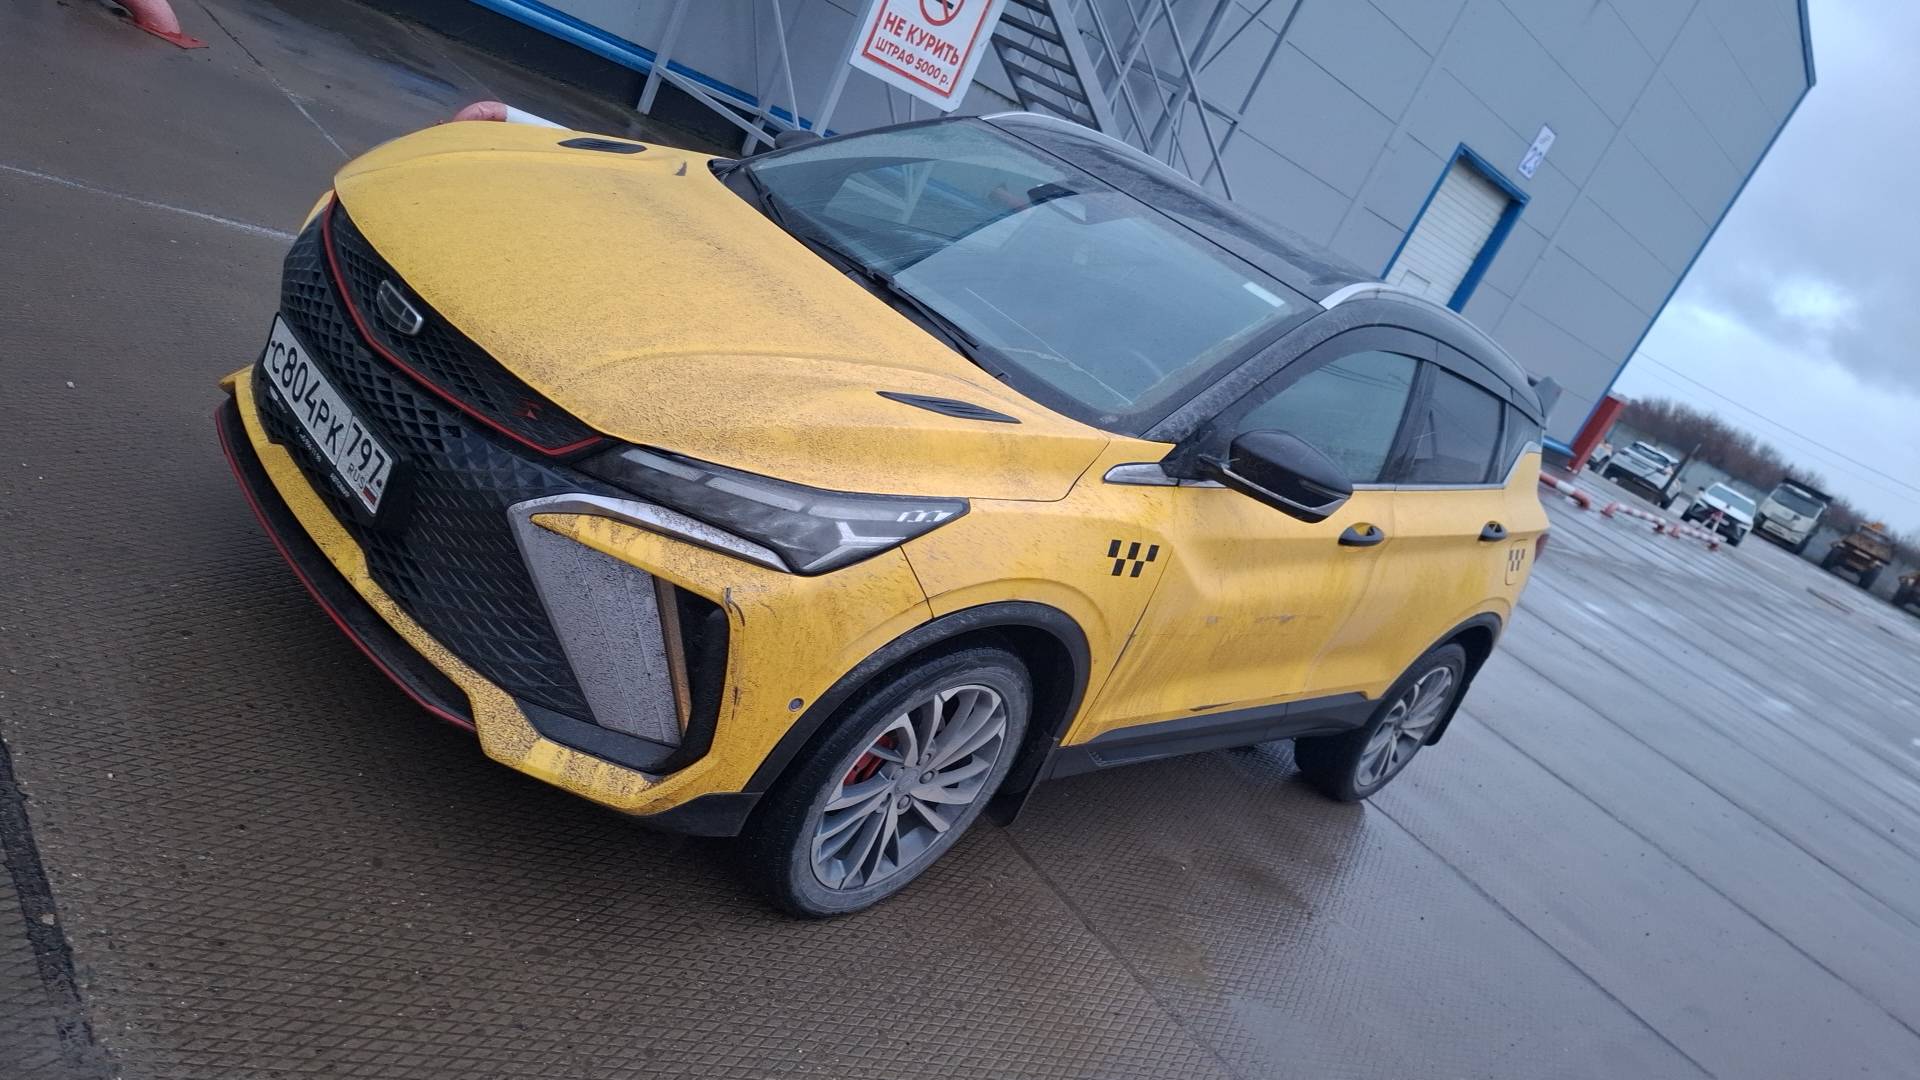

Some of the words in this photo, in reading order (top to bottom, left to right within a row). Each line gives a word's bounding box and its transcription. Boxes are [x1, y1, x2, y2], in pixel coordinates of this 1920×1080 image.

[874, 36, 915, 66] ШТРАФ
[914, 57, 941, 80] 5000
[883, 11, 907, 37] НЕ
[905, 23, 960, 66] КУРИТЬ
[346, 462, 366, 490] RUS
[347, 423, 386, 484] 797
